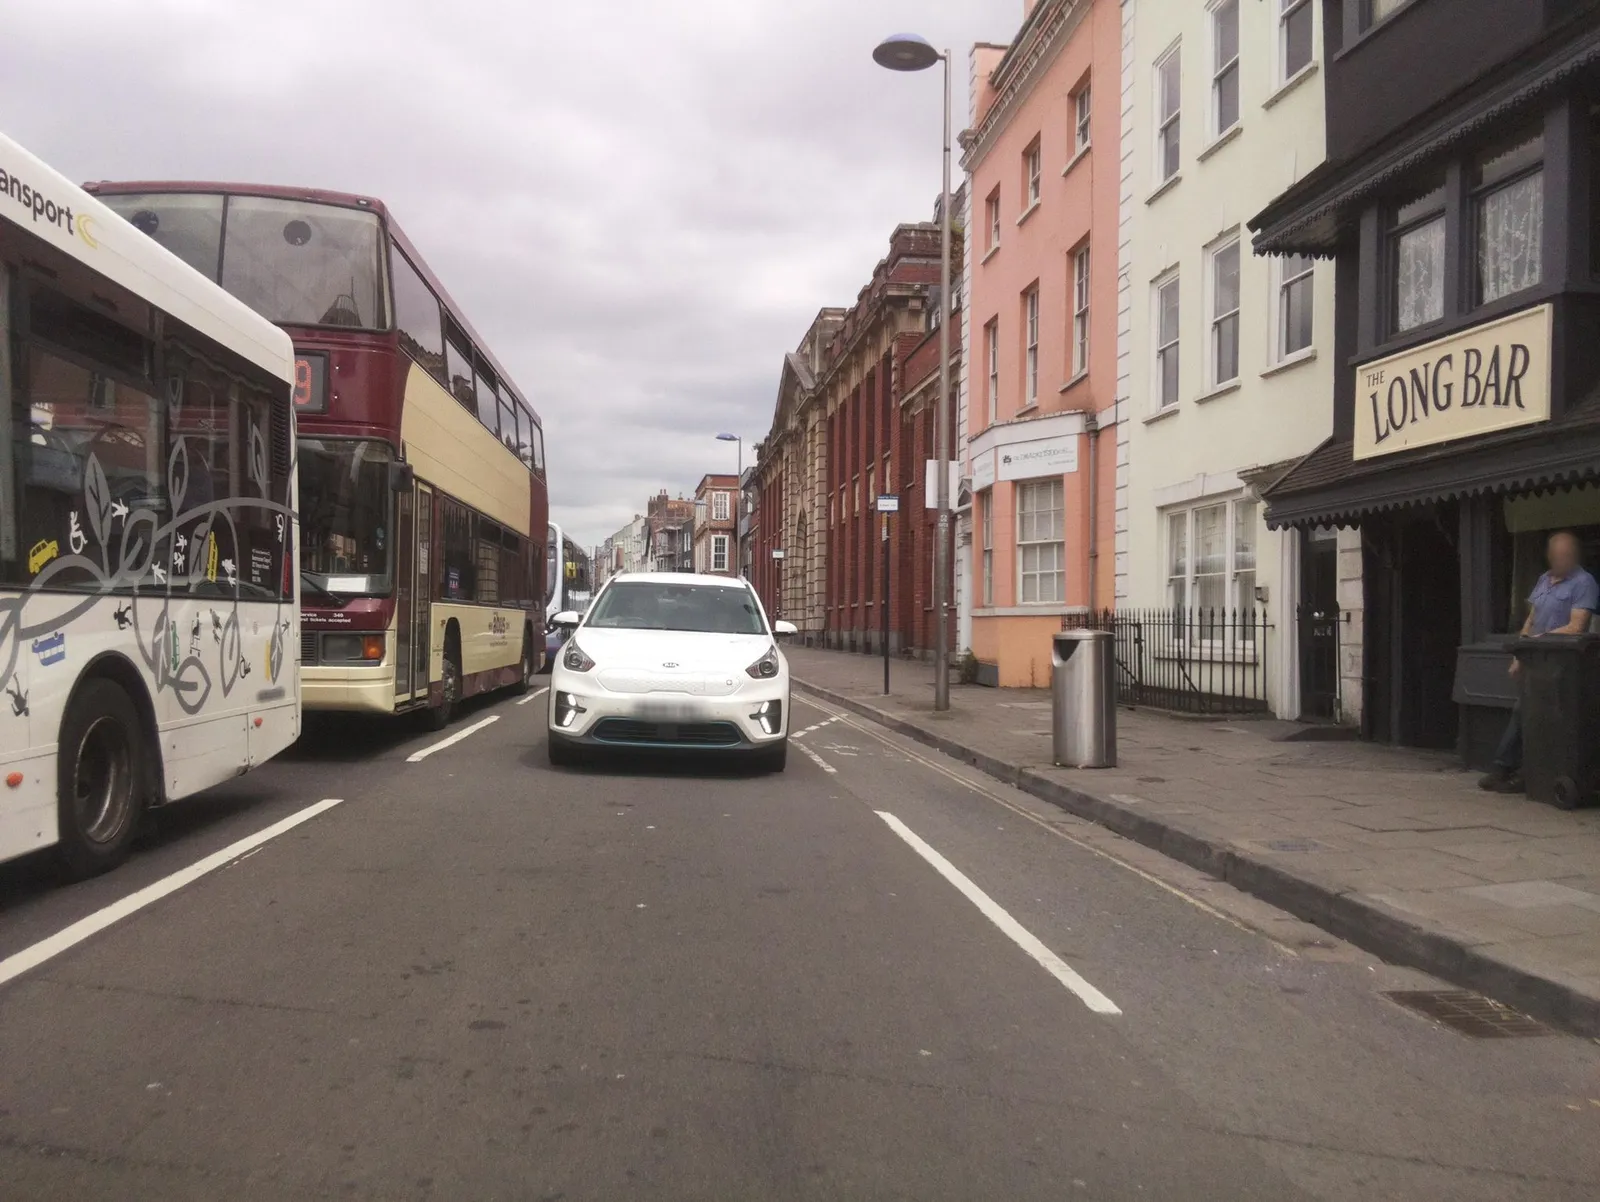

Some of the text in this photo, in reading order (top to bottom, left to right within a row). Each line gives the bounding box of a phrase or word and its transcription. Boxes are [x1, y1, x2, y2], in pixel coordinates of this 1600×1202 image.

[1366, 370, 1386, 388] THE
[1370, 343, 1531, 445] LONG BAR
